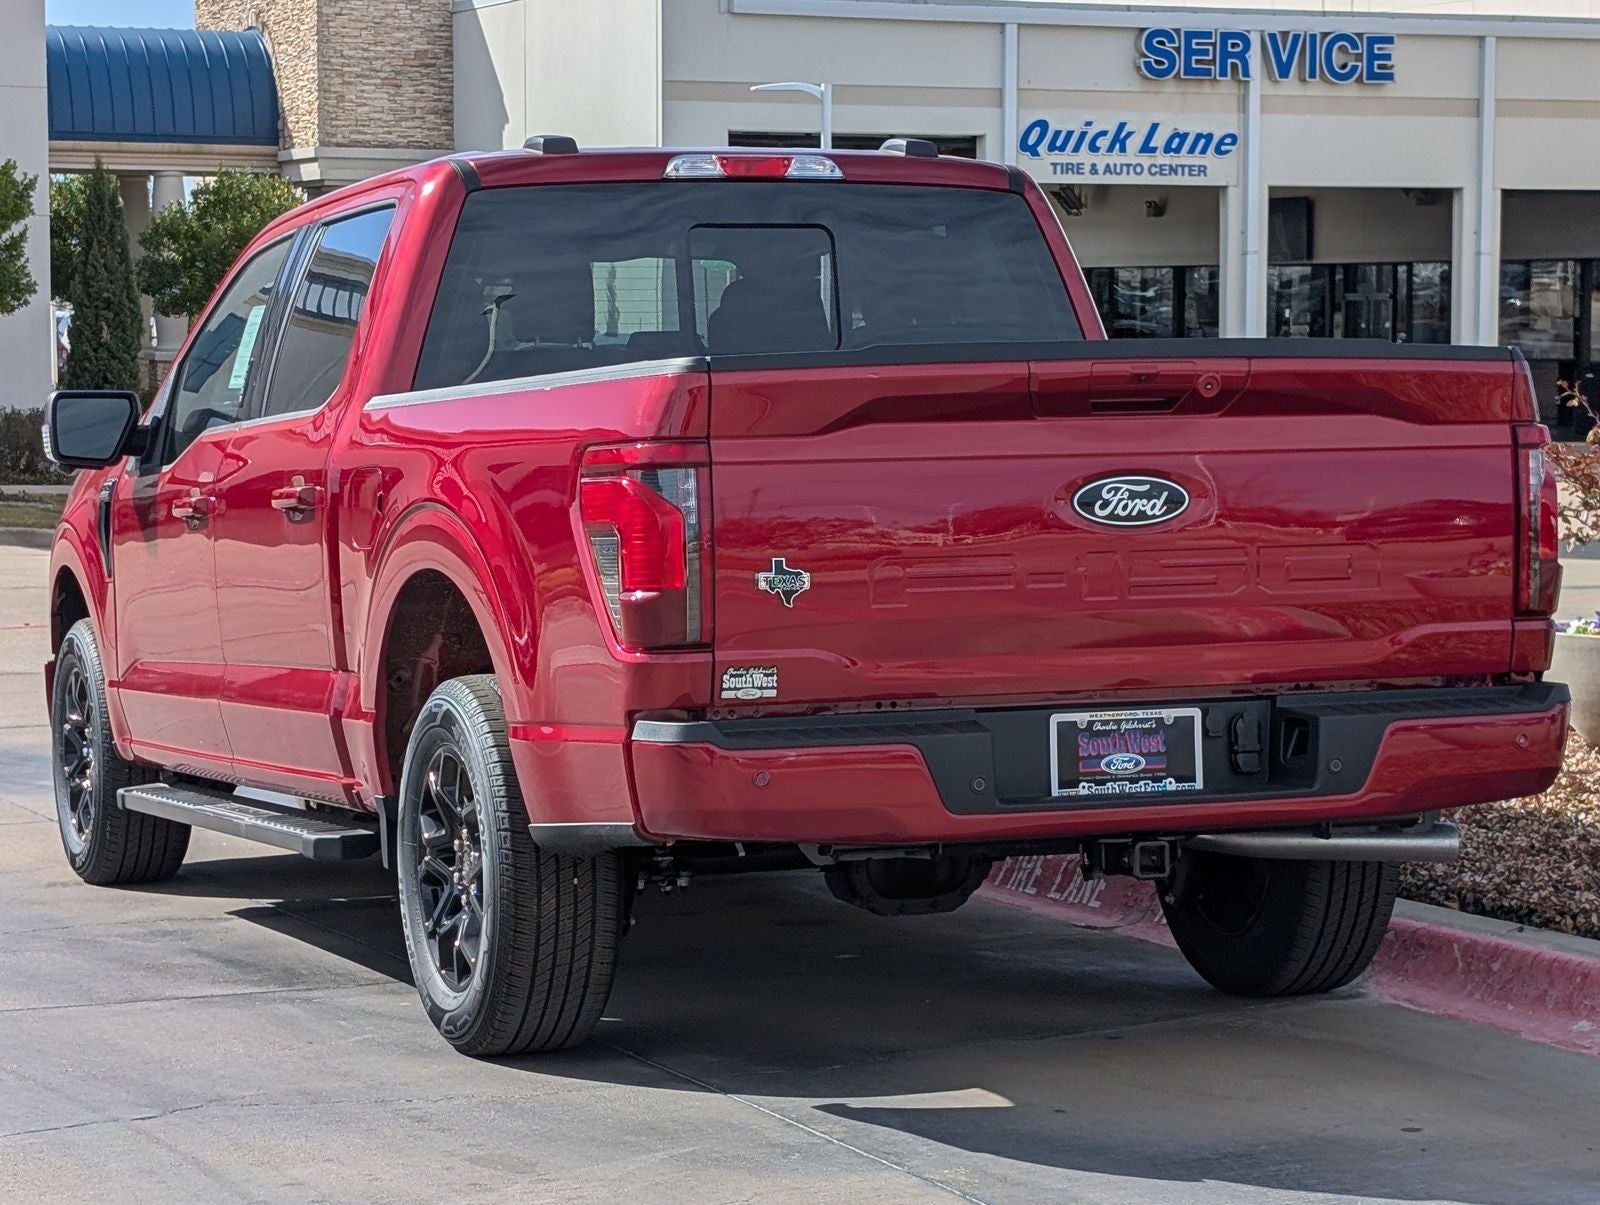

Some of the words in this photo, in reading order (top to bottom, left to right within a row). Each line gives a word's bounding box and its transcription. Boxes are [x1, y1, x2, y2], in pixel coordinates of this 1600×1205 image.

[1140, 28, 1396, 84] SERVICE
[1018, 118, 1136, 158] Quick
[1136, 122, 1240, 157] Lane
[1050, 162, 1085, 176] TIRE
[1088, 163, 1099, 176] &
[1102, 163, 1144, 177] AUTO
[1147, 163, 1208, 178] CENTER
[1094, 483, 1169, 517] Ford
[762, 575, 807, 588] TEXAS
[722, 673, 778, 688] SouthWest
[1078, 730, 1166, 757] SouthWest
[1110, 757, 1136, 770] Ford
